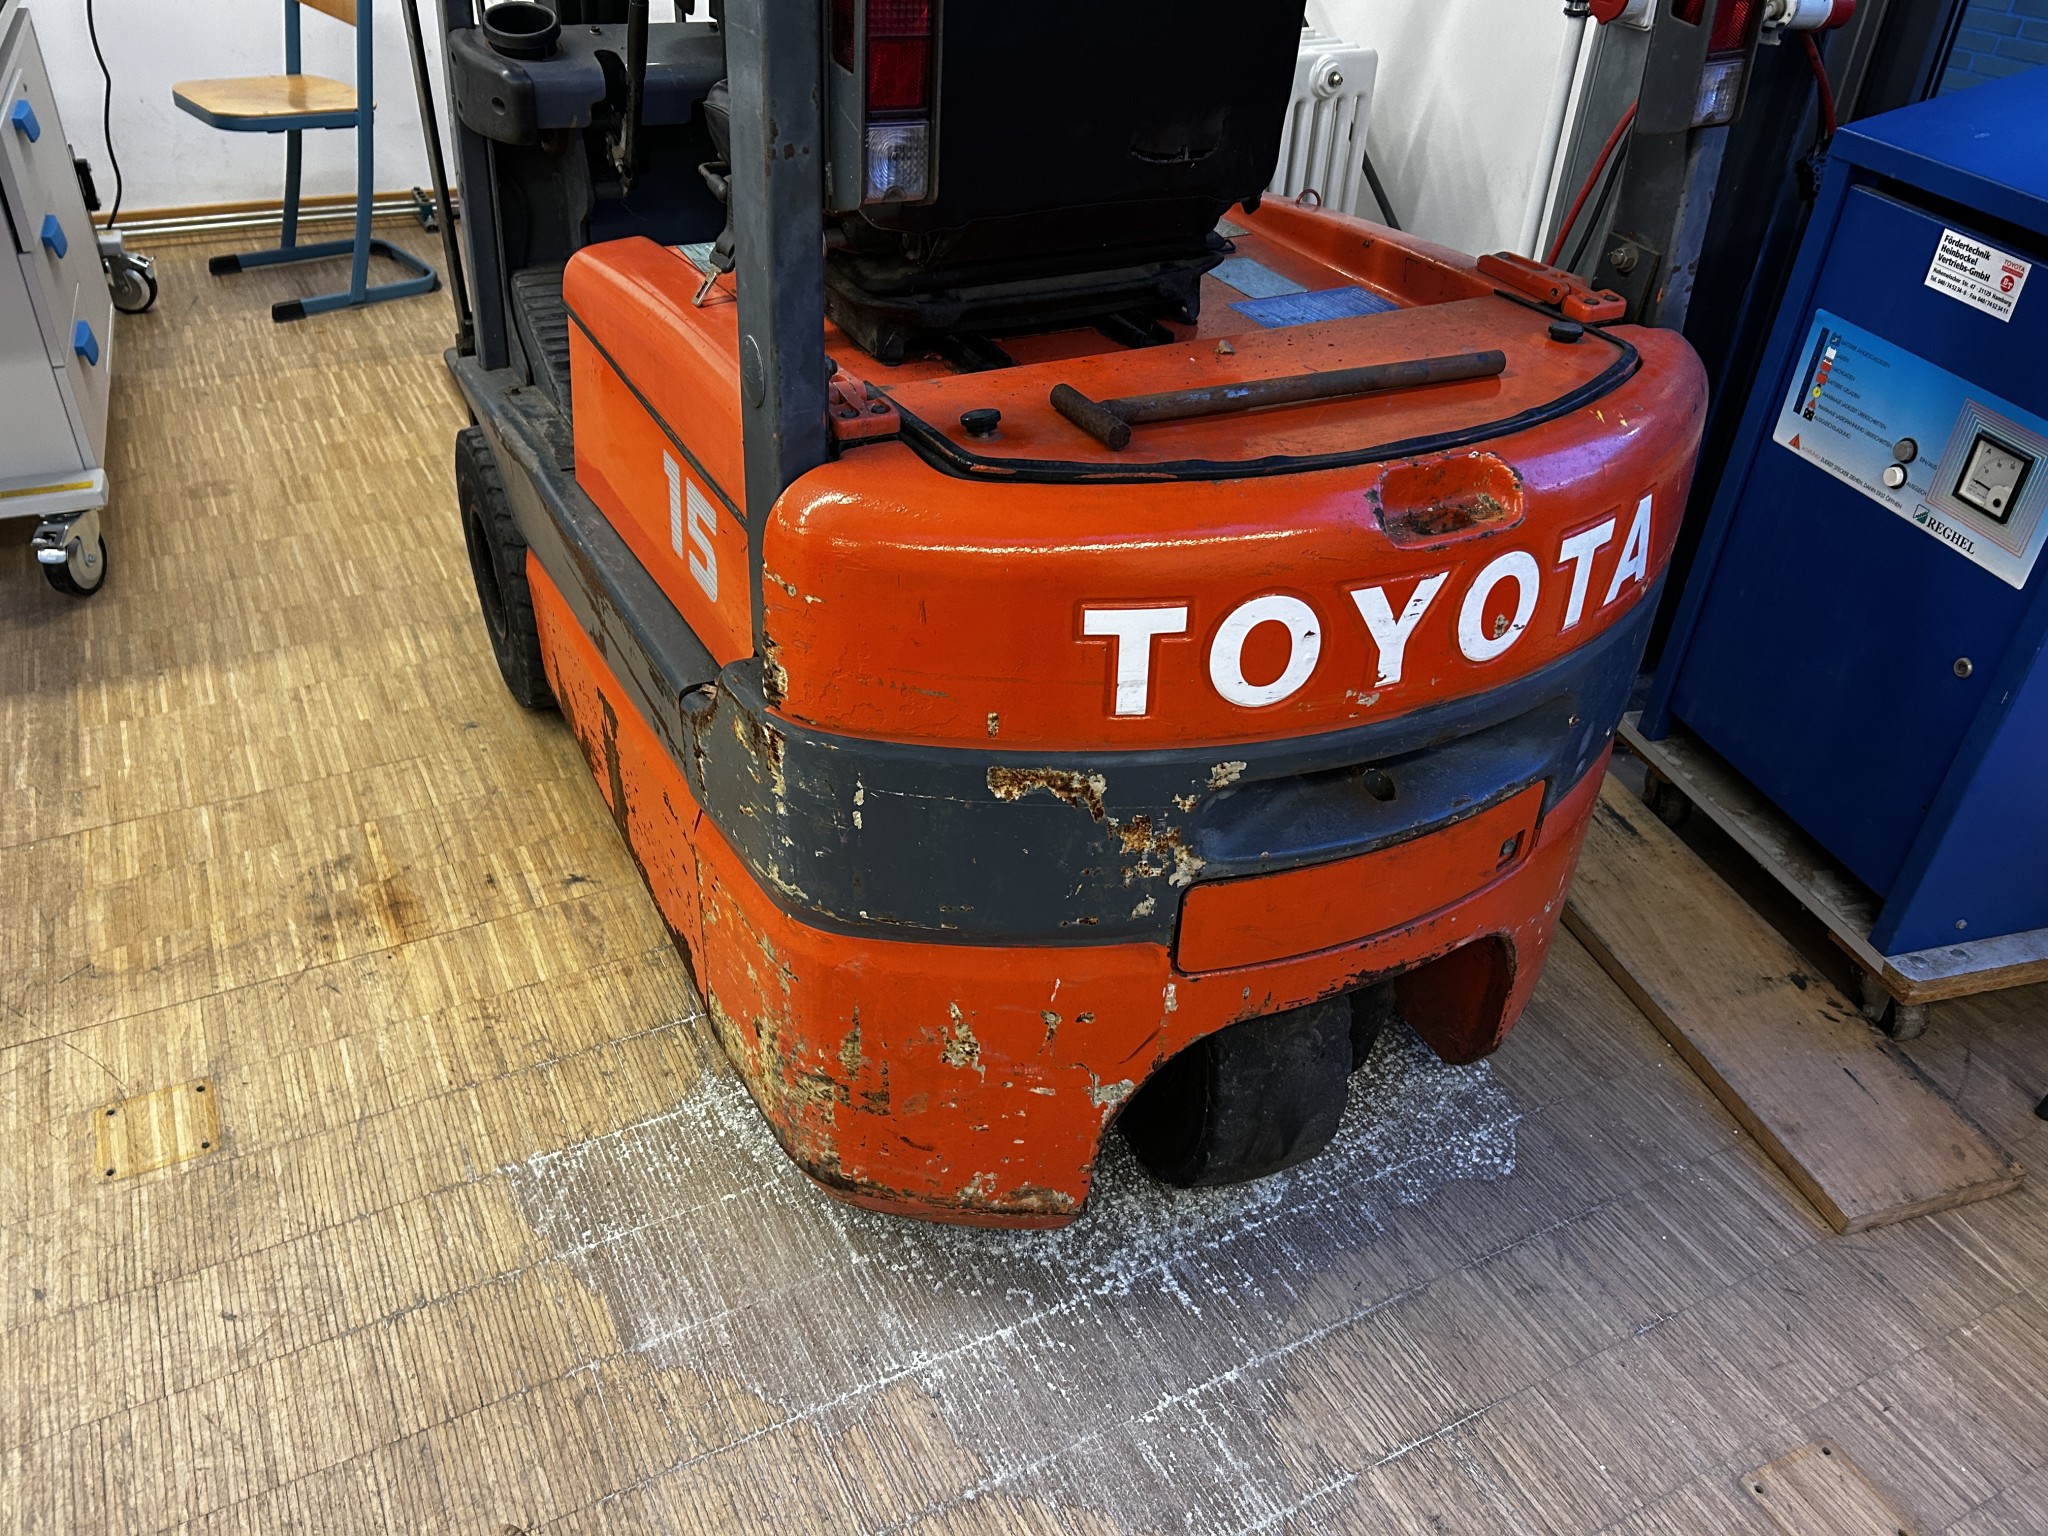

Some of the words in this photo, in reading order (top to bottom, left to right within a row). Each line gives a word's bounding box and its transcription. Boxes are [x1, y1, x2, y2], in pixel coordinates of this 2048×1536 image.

[1940, 243, 1978, 265] Heinbockel
[1944, 234, 1991, 260] Fördertechnik
[1937, 252, 1990, 282] Vertriebs-GmbH
[2003, 259, 2025, 272] TOYOTA
[1961, 279, 1969, 287] Str.
[1978, 287, 1991, 297] 21129
[1991, 293, 2012, 307] Hamburg
[1968, 292, 1977, 300] Fax
[663, 449, 718, 603] 15
[1926, 517, 1975, 554] REGHEL
[1083, 494, 1654, 716] TOYOTA
